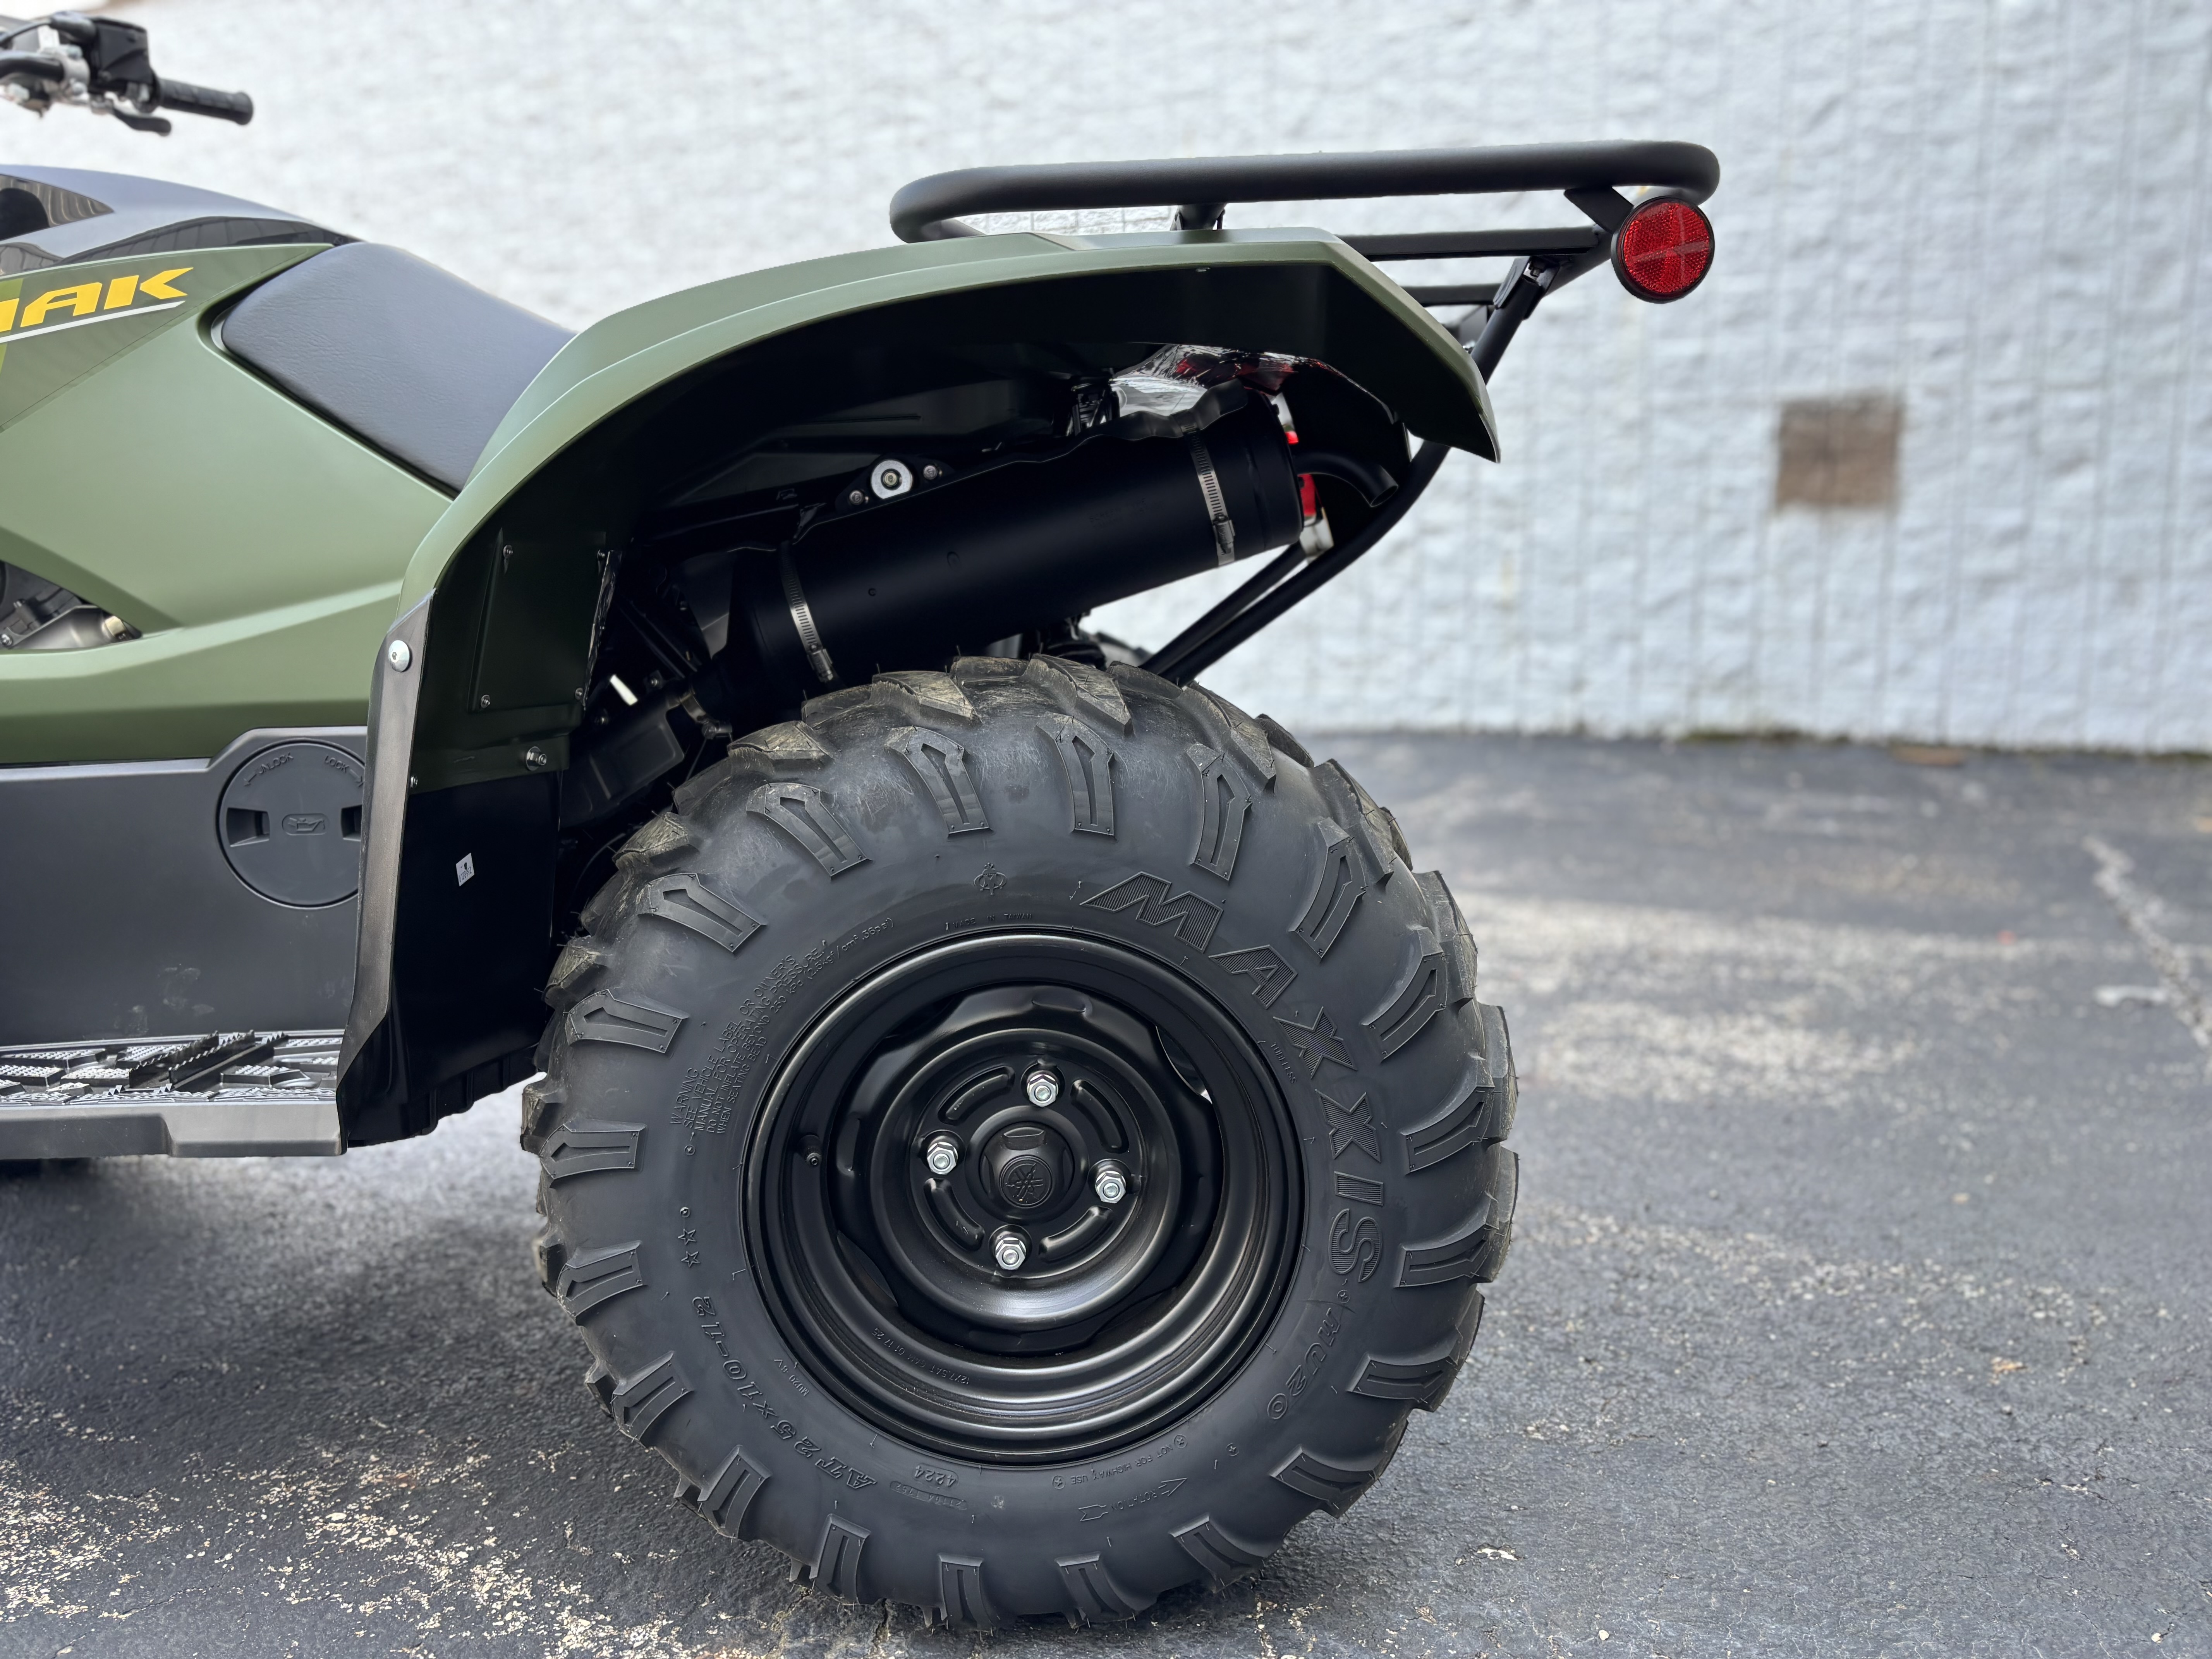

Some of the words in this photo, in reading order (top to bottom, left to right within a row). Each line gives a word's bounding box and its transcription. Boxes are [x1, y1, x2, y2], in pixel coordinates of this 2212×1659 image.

[258, 752, 293, 775] UNLOCK
[325, 755, 349, 773] LOCK
[785, 978, 804, 994] kPa
[769, 994, 787, 1013] 250
[682, 1104, 698, 1129] SEE
[690, 1054, 719, 1100] VEHICLE
[713, 1019, 742, 1052] LABEL
[738, 998, 755, 1015] OR
[752, 953, 796, 998] OWNER'S
[694, 1085, 717, 1131] MANUAL
[712, 1056, 731, 1080] FOR
[726, 995, 771, 1053] OPERATING
[769, 946, 825, 994] PRESSURE.
[741, 1014, 771, 1051] BEYOND
[721, 1052, 746, 1091] INFLATE
[1080, 871, 1384, 1282] MAXXIS
[670, 1066, 699, 1124] WARNING
[716, 1106, 732, 1134] WHEN
[726, 1063, 750, 1104] SEATING
[747, 1036, 767, 1061] BEAD
[711, 1094, 725, 1115] NOT
[706, 1118, 717, 1133] DO
[871, 1328, 885, 1340] 25
[1264, 1307, 1342, 1421] MU20
[788, 1374, 809, 1396] MU20
[1135, 1454, 1154, 1467] FOR
[1156, 1444, 1173, 1459] NOT
[913, 1465, 955, 1487] 4224
[1069, 1474, 1089, 1485] USE
[1092, 1463, 1132, 1480] HIGHWAY
[1111, 1490, 1158, 1511] ROTATION
